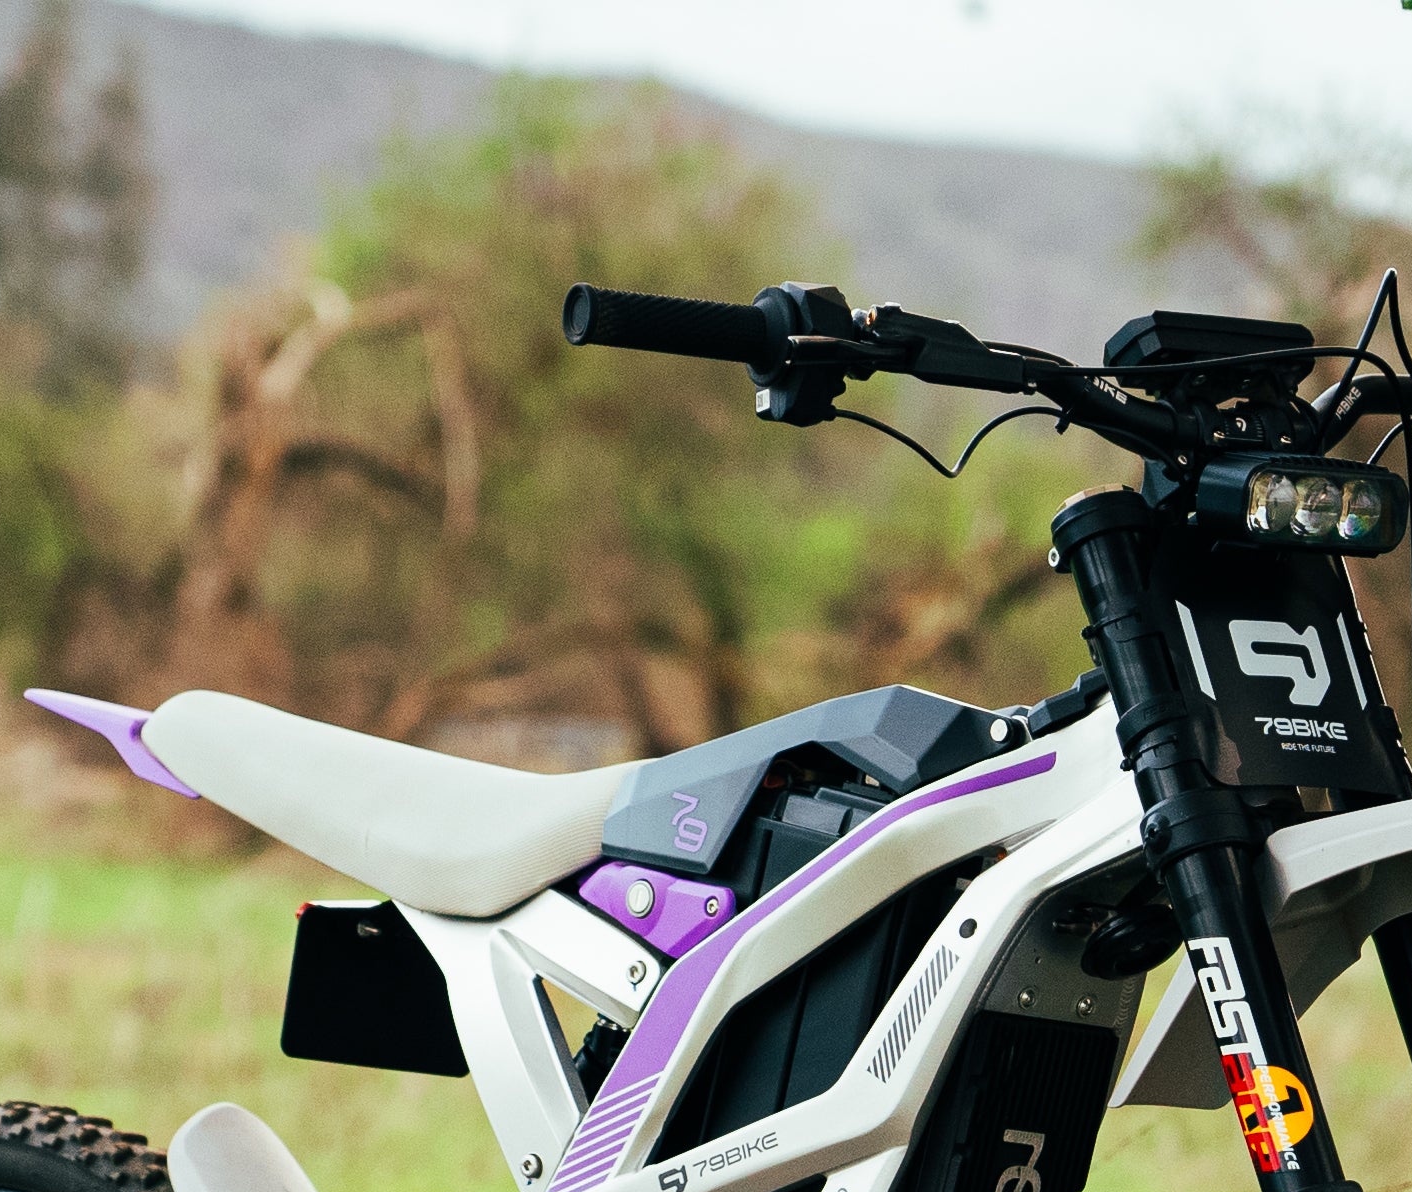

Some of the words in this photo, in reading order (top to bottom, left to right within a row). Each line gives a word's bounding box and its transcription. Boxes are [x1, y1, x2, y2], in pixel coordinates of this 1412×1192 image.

[1254, 716, 1348, 740] 79BIKE
[672, 791, 708, 853] 79
[1258, 1065, 1301, 1171] PERFORMANCE
[692, 1131, 779, 1177] 79BIKE
